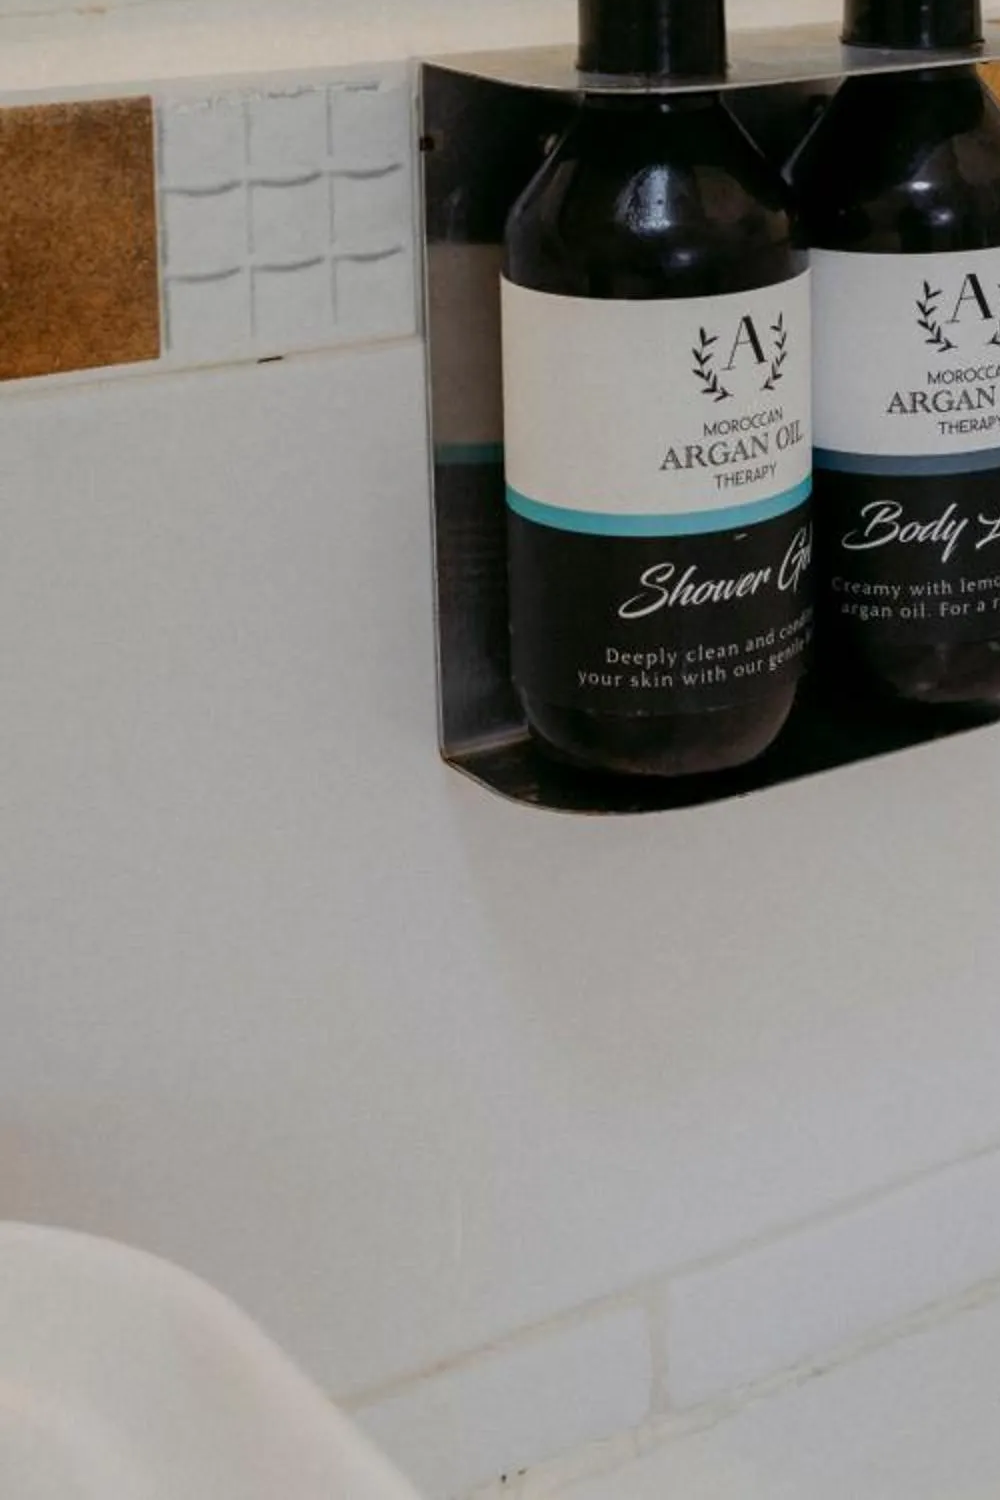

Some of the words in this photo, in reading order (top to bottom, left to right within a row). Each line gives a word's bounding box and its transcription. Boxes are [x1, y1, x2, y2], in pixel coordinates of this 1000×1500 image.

[945, 273, 993, 324] A
[723, 314, 768, 371] A
[886, 386, 997, 415] ARGAN
[703, 407, 783, 437] MOROCCAN
[660, 431, 770, 471] ARGAN
[776, 419, 803, 449] OIL
[714, 462, 777, 491] THERAPY
[842, 500, 968, 563] Body
[618, 563, 771, 619] Shower
[831, 575, 901, 600] Creamy
[909, 579, 953, 596] with
[841, 602, 893, 621] argan
[900, 601, 932, 619] oil.
[939, 600, 974, 617] For
[977, 599, 985, 613] a
[605, 646, 678, 671] Deeply
[686, 640, 740, 665] clean
[745, 628, 775, 652] and
[577, 668, 623, 689] your
[630, 666, 674, 689] skin
[682, 664, 727, 686] with
[733, 657, 765, 679] our
